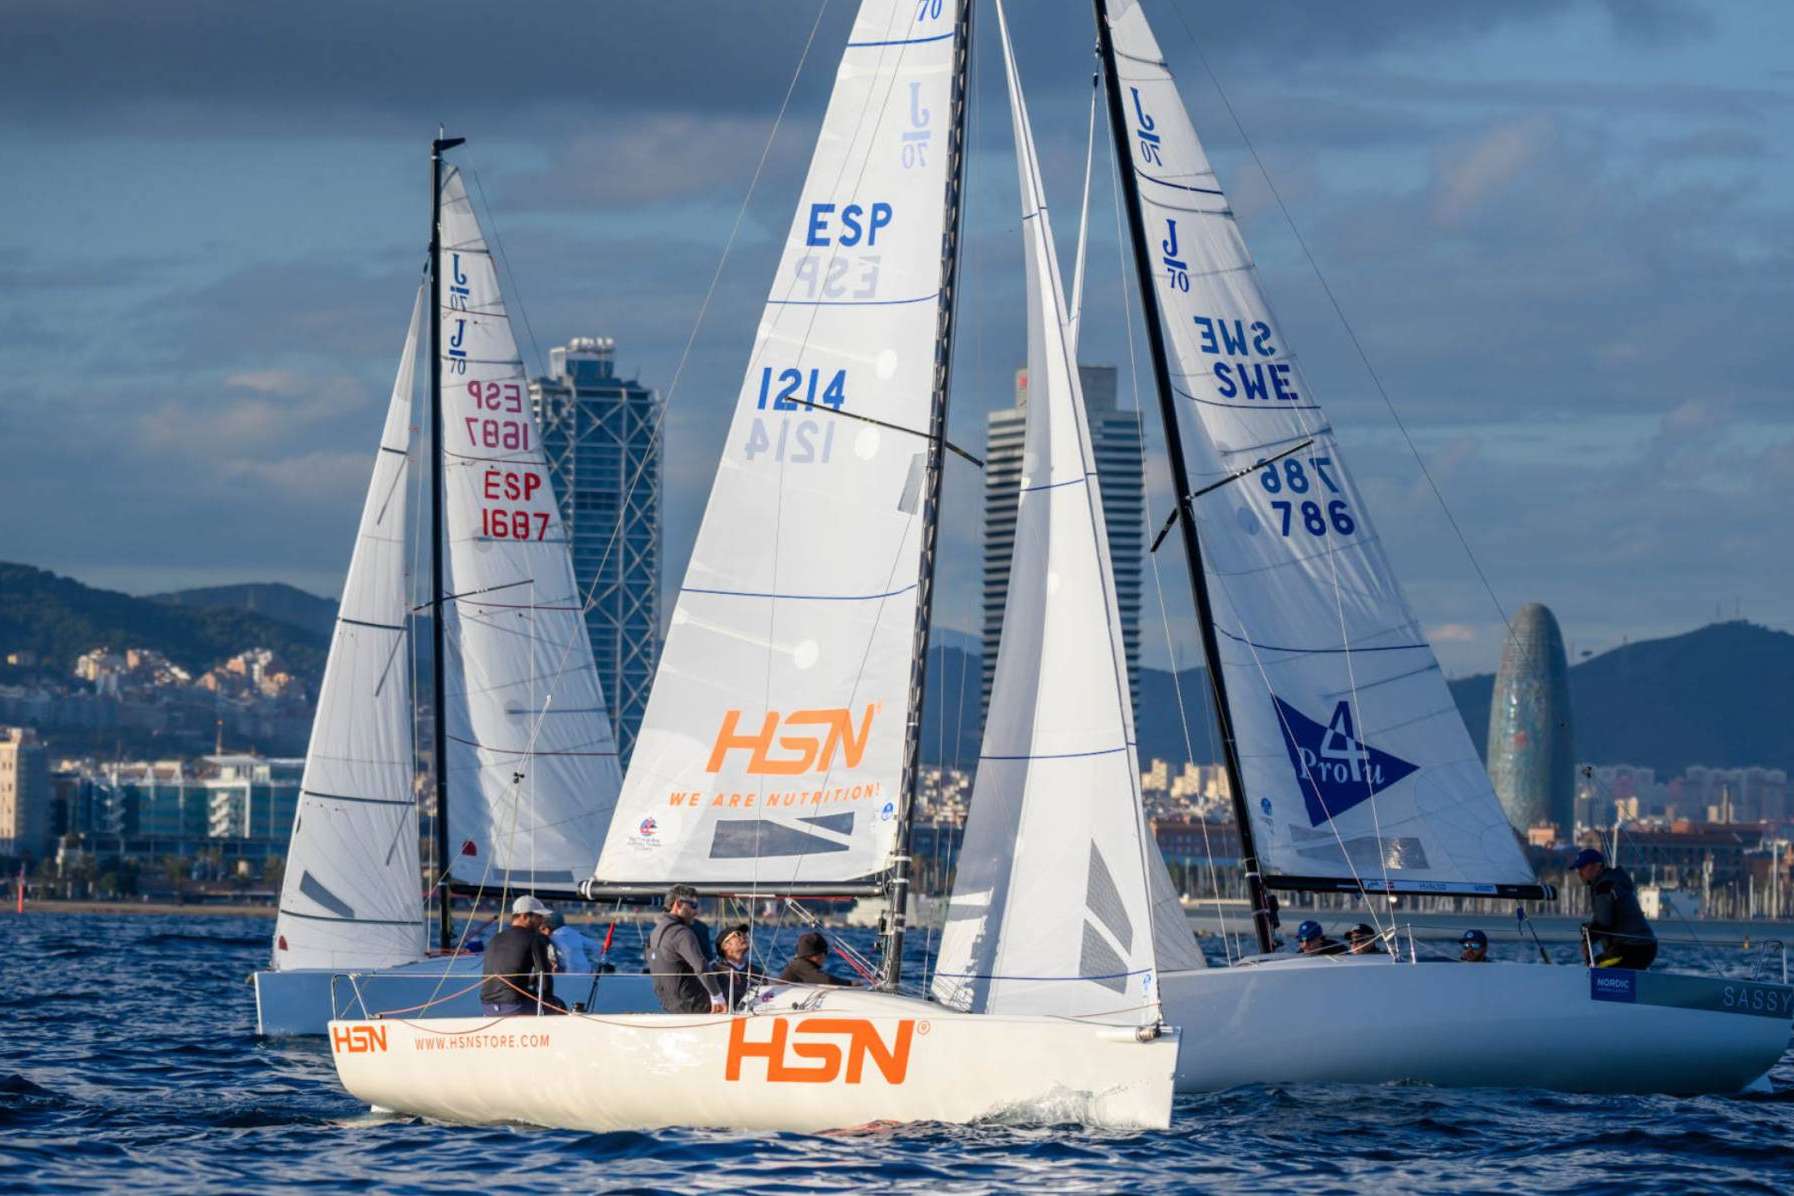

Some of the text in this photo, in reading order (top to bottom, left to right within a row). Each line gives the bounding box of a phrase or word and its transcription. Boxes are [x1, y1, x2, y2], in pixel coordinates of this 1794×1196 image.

[806, 202, 893, 247] ESP
[1162, 218, 1178, 258] J
[1167, 268, 1190, 293] 70
[450, 319, 465, 350] J
[449, 359, 466, 375] 70
[1213, 361, 1299, 401] SWE
[757, 366, 848, 412] 1214
[485, 470, 542, 501] ESP
[482, 507, 550, 542] 1687
[1271, 500, 1357, 537] 786
[668, 783, 880, 807] WE ARE NUTRITION!
[1597, 978, 1629, 989] NORDIC
[1722, 986, 1793, 1013] SASSY
[333, 1025, 387, 1053] HSN
[415, 1034, 550, 1050] WWW.HSNSTORE.COM
